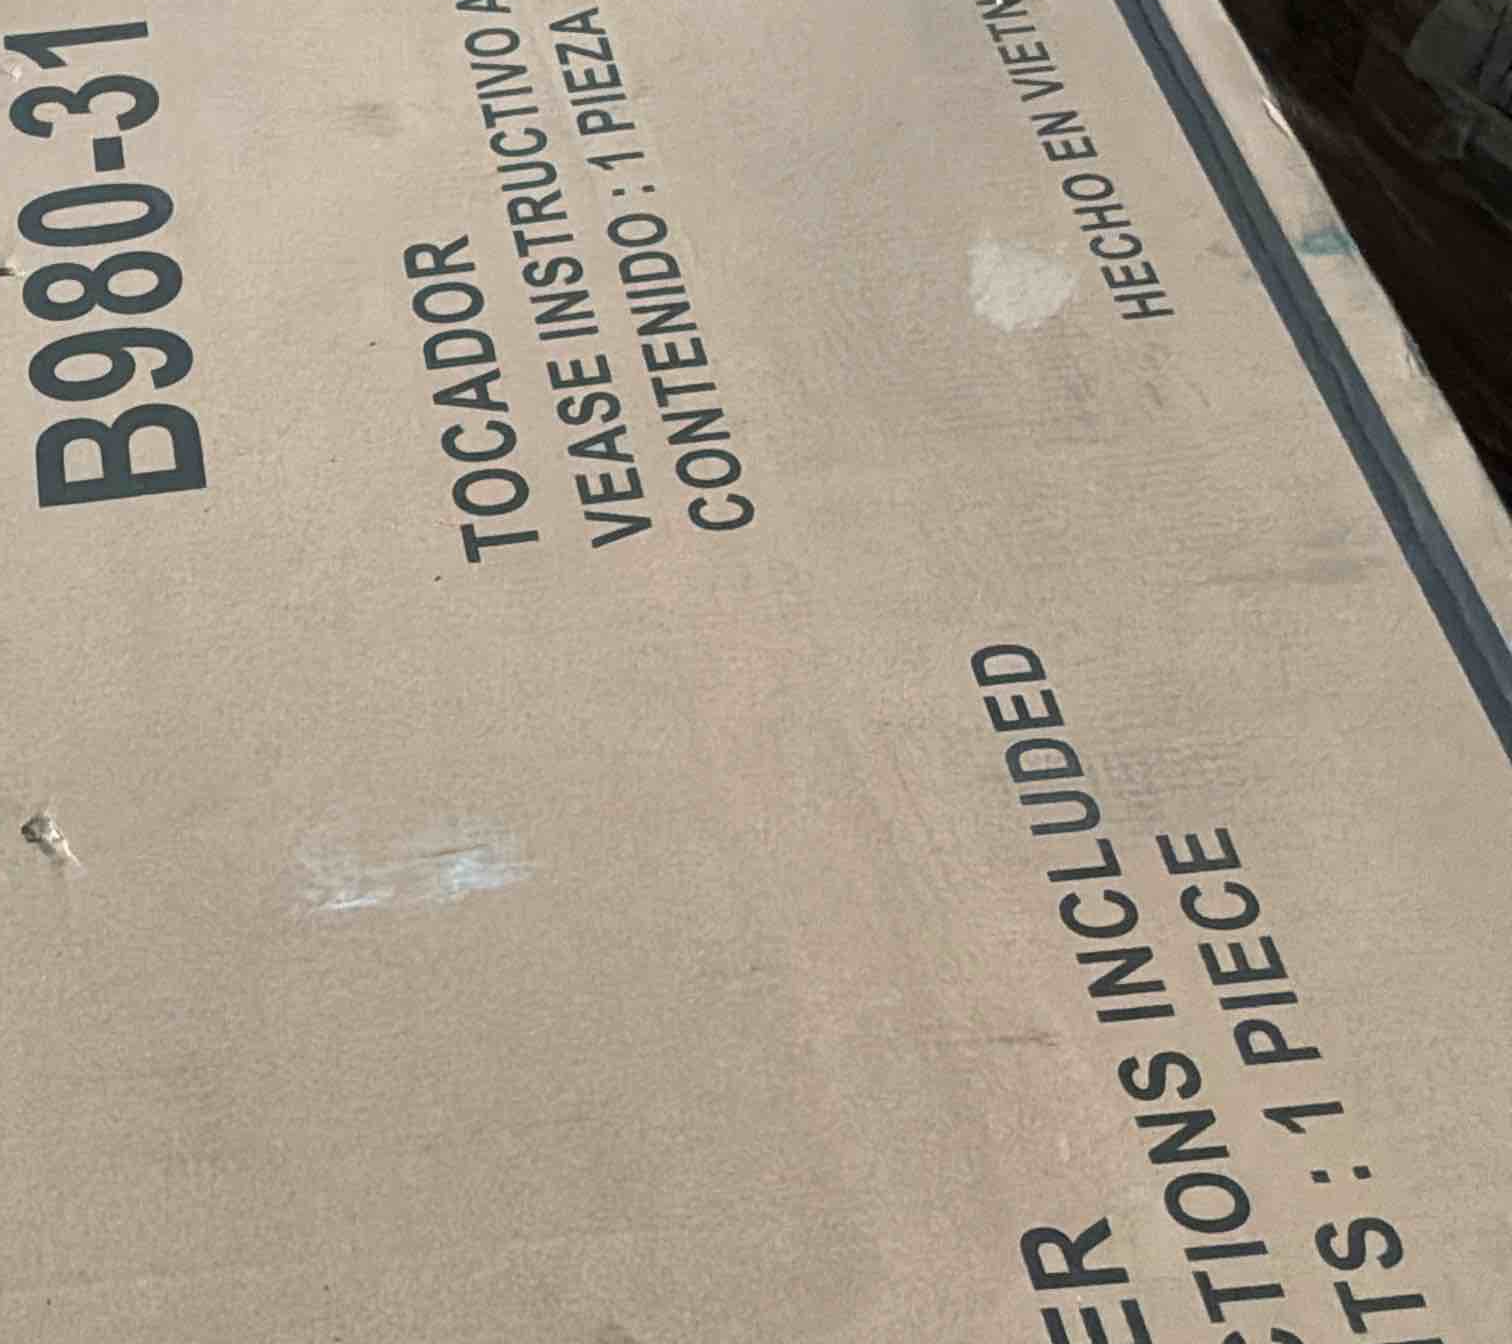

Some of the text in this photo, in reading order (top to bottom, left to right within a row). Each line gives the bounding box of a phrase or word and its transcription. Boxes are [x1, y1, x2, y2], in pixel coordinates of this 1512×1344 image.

[548, 6, 636, 137] PIEZA
[586, 151, 645, 171] 1
[1030, 109, 1099, 162] EN
[3, 20, 208, 508] B980-31
[464, 27, 600, 342] INSTRUCTIVO
[1061, 172, 1175, 321] HECHO
[403, 234, 540, 564] TOCADOR
[545, 353, 653, 549] VEASE
[606, 212, 756, 532] CONTENIDO
[970, 643, 1176, 1024] INCLUDED
[1154, 827, 1323, 1067] PIECE
[1261, 1100, 1345, 1135] 1
